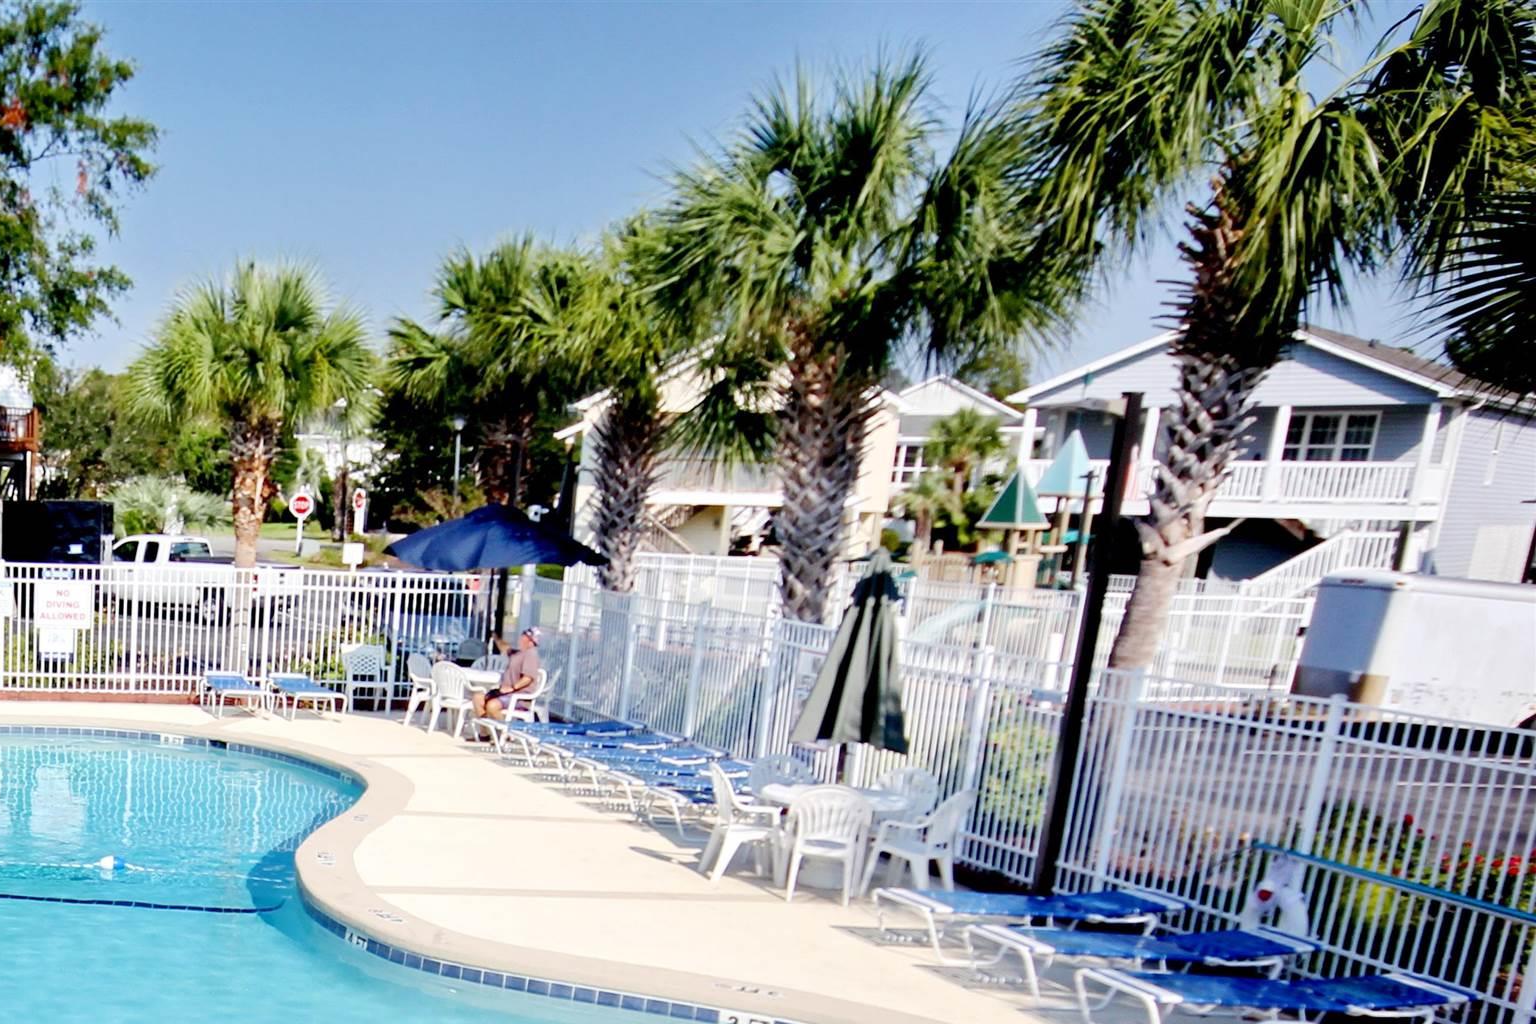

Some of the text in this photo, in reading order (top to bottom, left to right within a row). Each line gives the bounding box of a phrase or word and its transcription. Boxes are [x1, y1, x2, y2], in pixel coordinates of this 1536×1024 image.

[56, 589, 70, 597] NO
[45, 600, 80, 609] DIVING
[39, 612, 86, 620] ALLOWED
